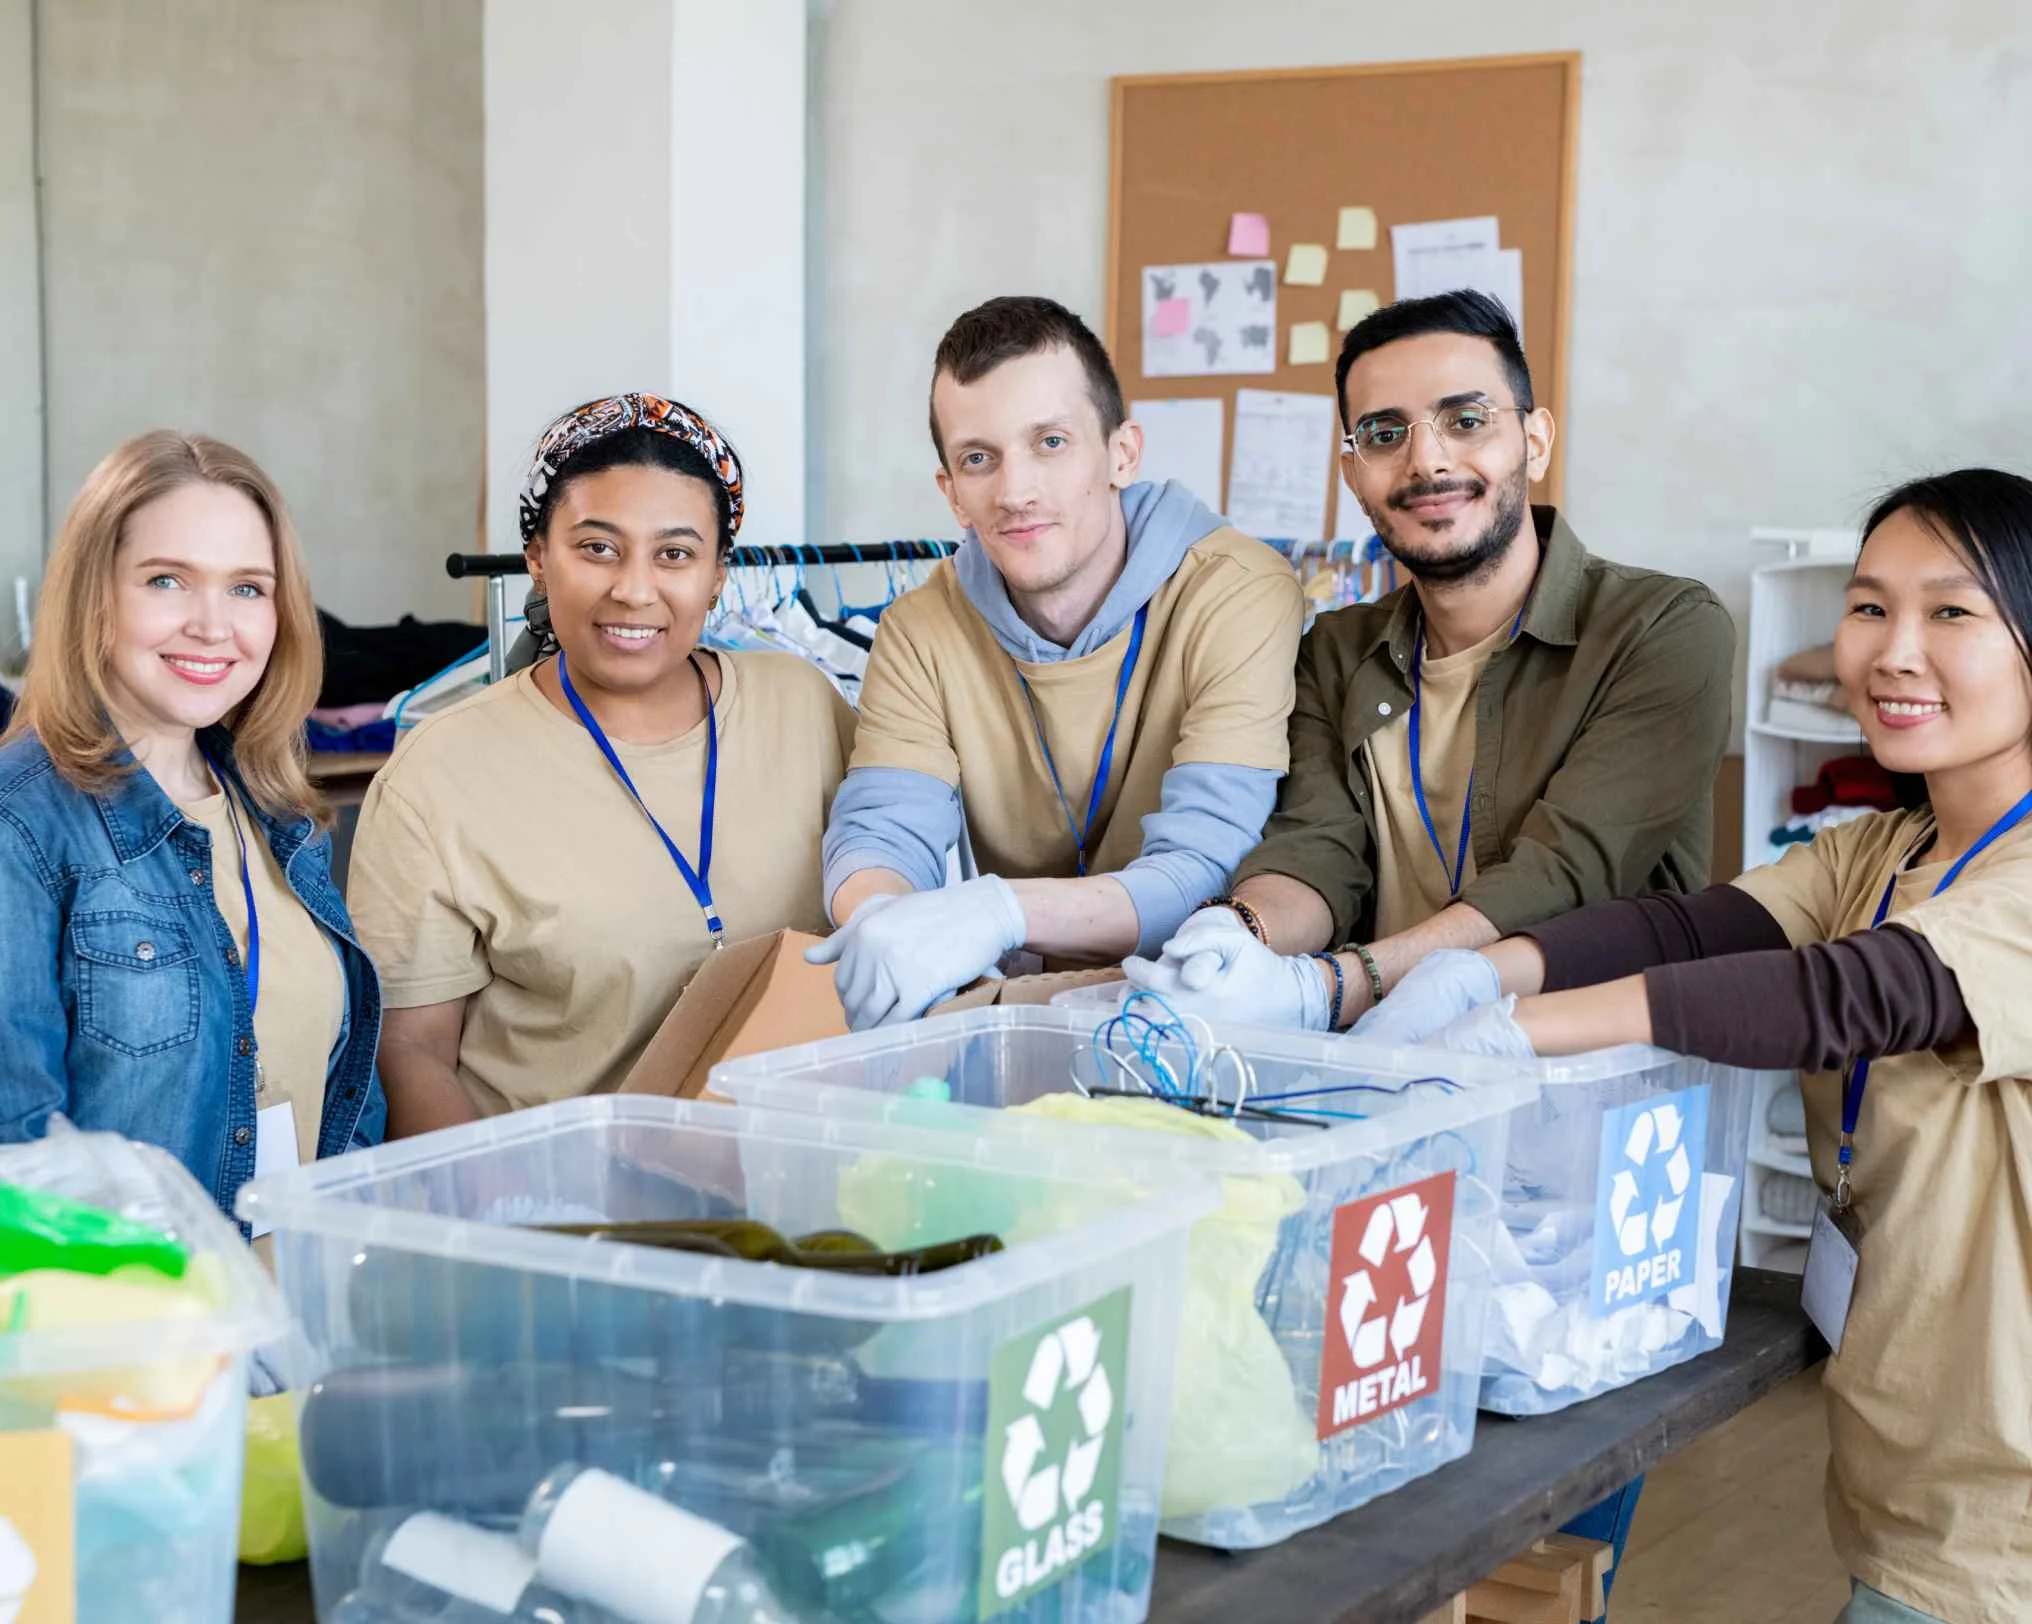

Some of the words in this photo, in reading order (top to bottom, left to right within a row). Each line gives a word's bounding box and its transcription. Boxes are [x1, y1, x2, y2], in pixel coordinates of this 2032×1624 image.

[1604, 1248, 1682, 1305] PAPER
[1332, 1355, 1428, 1426] METAL
[996, 1499, 1104, 1599] GLASS
